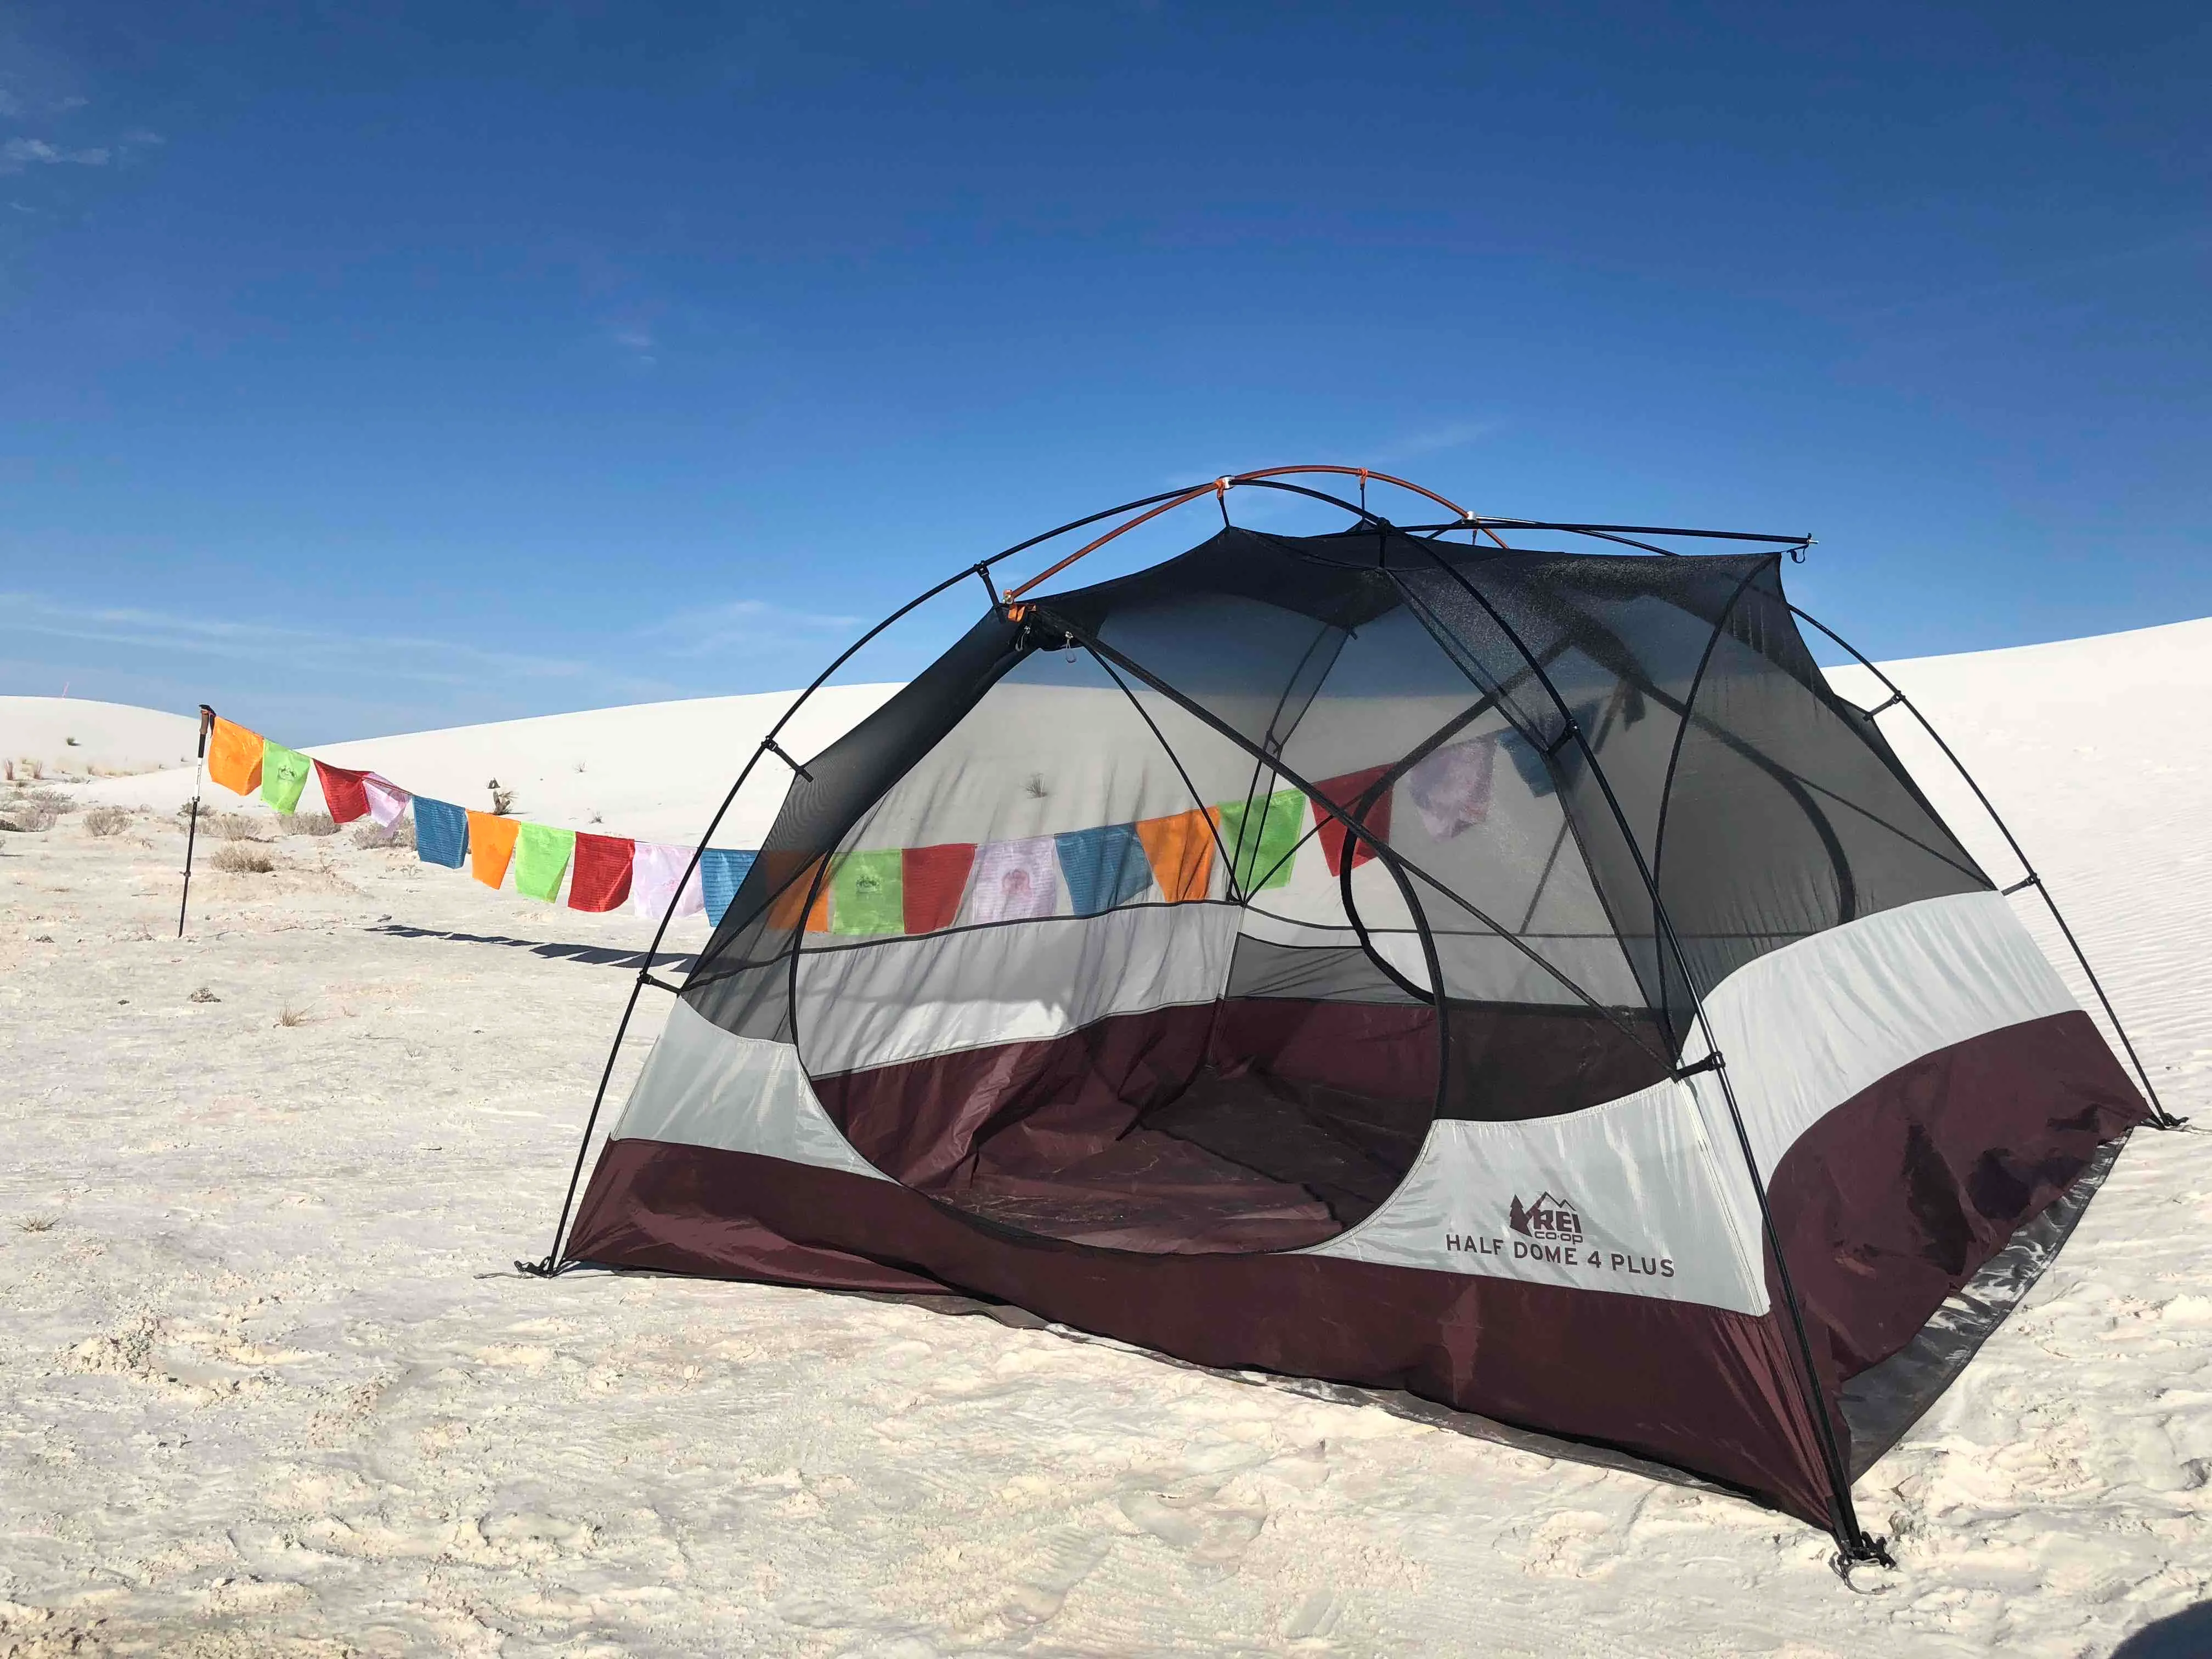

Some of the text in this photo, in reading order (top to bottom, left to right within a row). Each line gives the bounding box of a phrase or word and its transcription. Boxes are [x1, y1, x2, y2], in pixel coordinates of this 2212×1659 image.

[1533, 1210, 1582, 1234] REI
[1446, 1234, 1675, 1278] HALF DOME 4 PLUS
